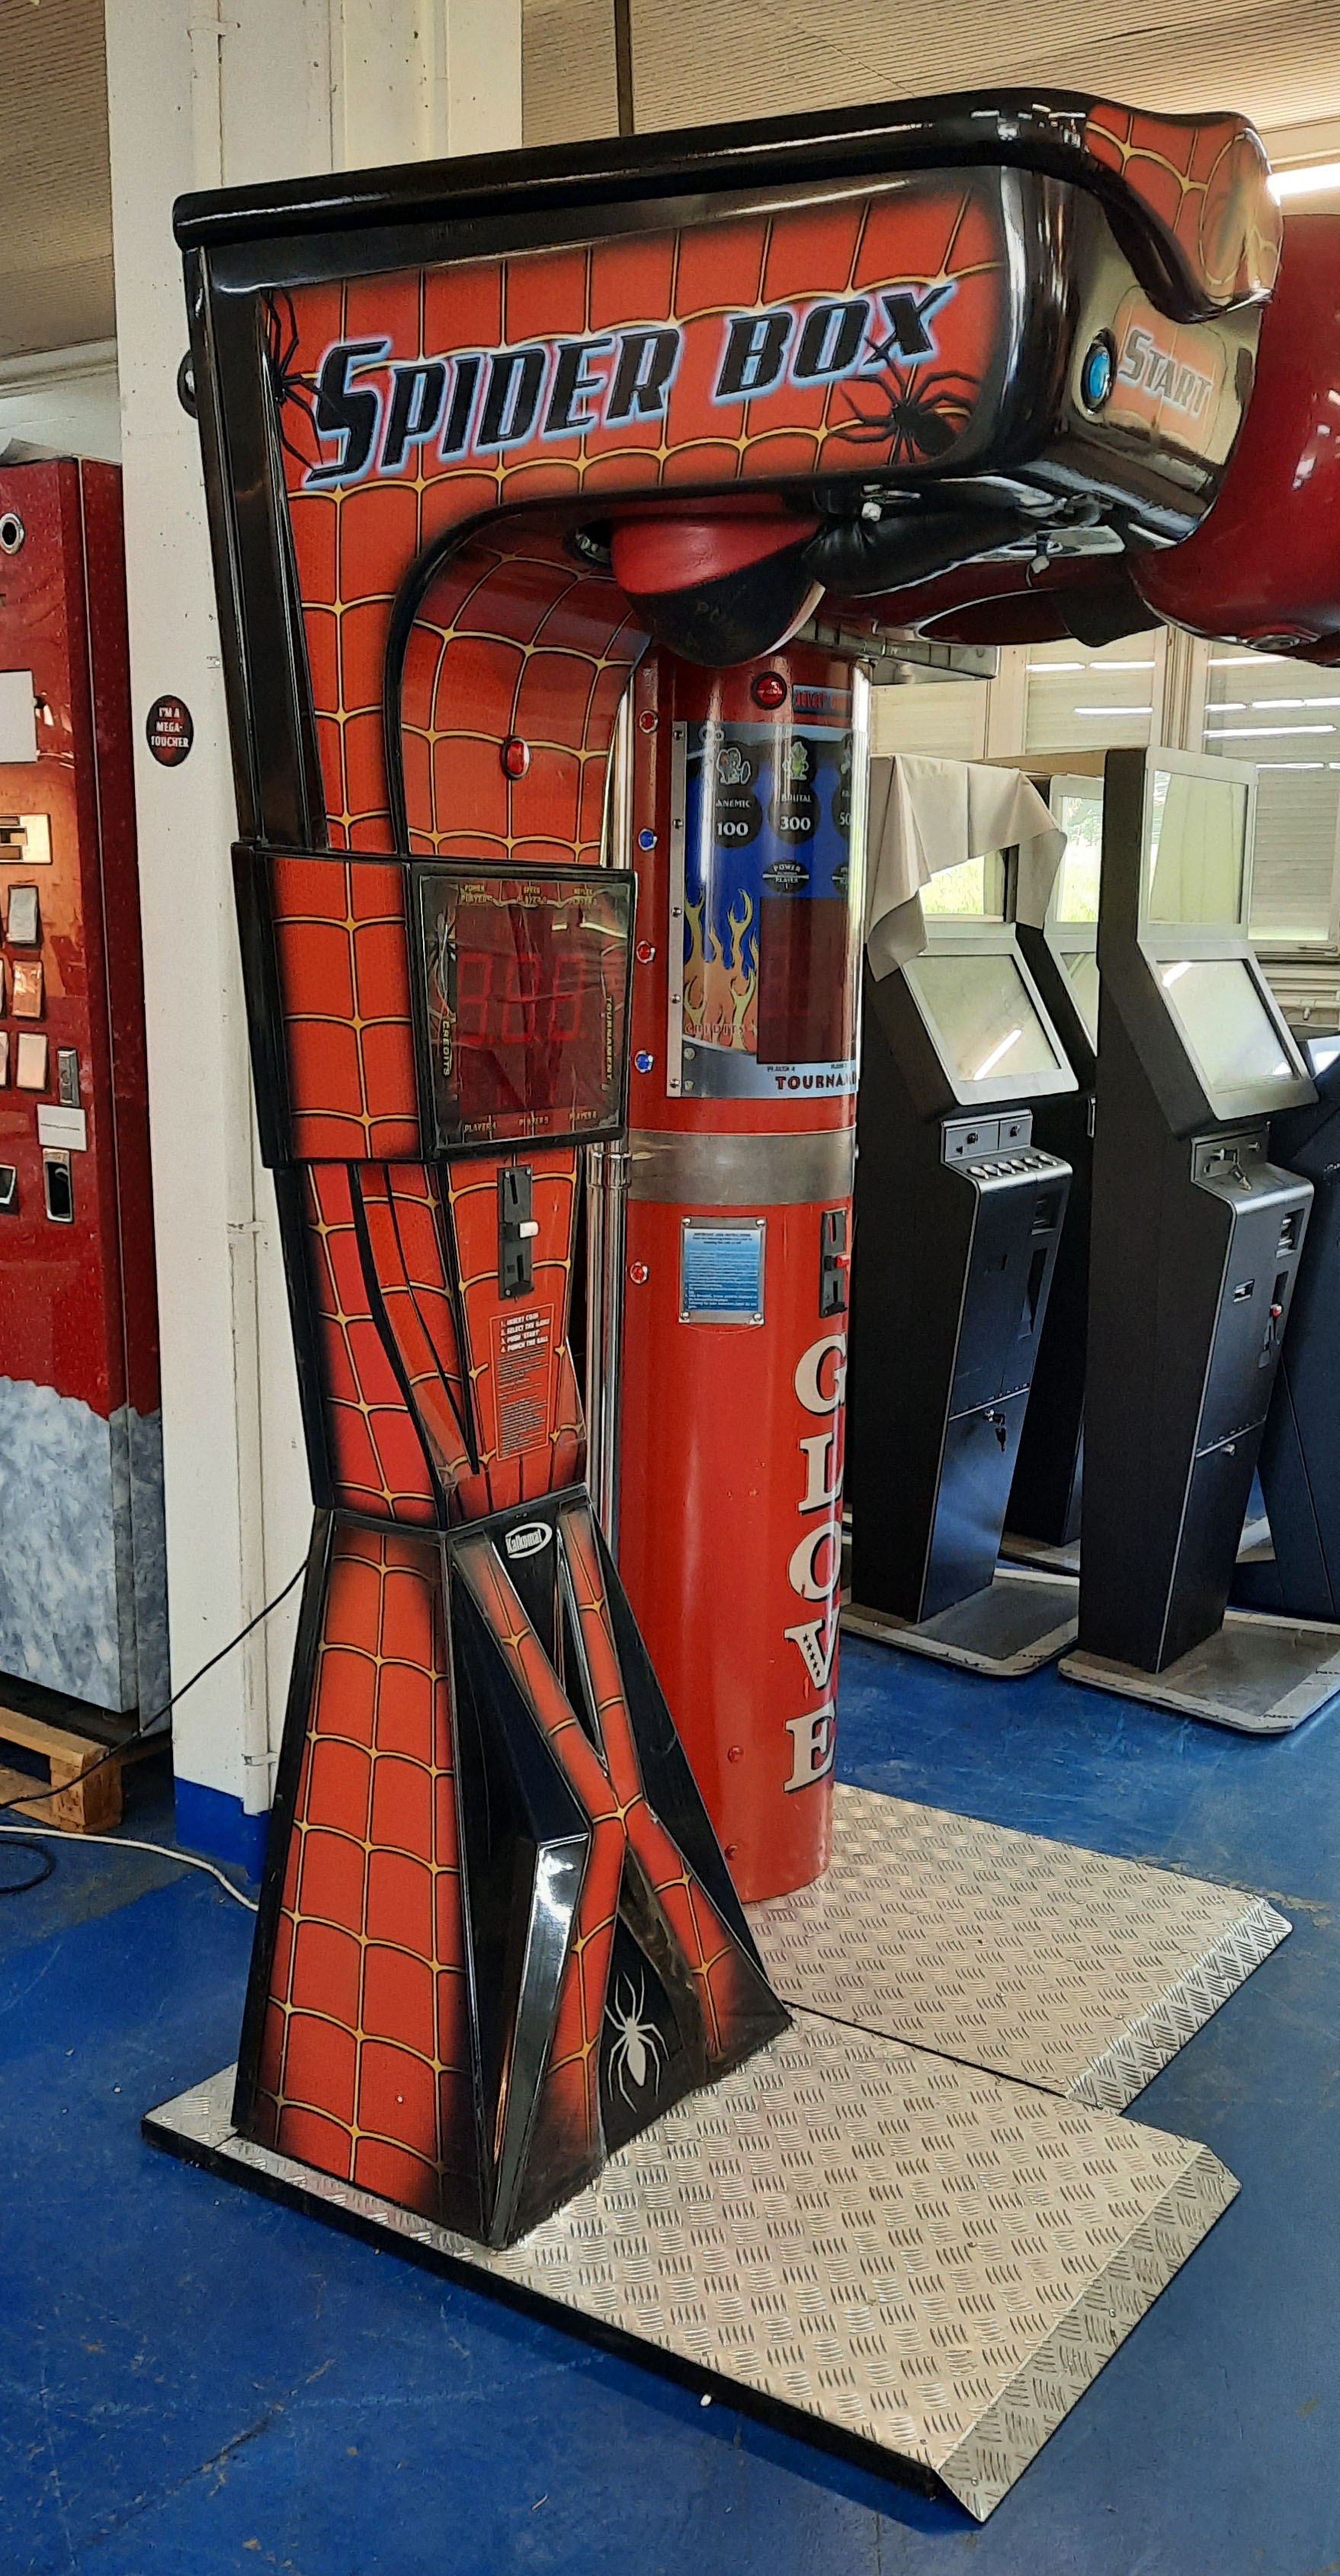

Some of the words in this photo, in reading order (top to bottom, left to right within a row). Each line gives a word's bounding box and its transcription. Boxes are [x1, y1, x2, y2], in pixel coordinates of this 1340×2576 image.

[1118, 328, 1213, 415] START
[303, 328, 681, 486] SPIDER
[713, 284, 954, 402] BOX
[158, 707, 172, 717] I'M
[174, 707, 180, 717] A
[155, 721, 183, 732] MEGA-
[150, 736, 189, 747] TOUCHER
[715, 799, 751, 809] ANEMIC
[716, 822, 749, 836] 100
[779, 816, 811, 831] 300
[442, 1019, 451, 1077] CREDITS
[783, 1334, 846, 1793] GLOVE
